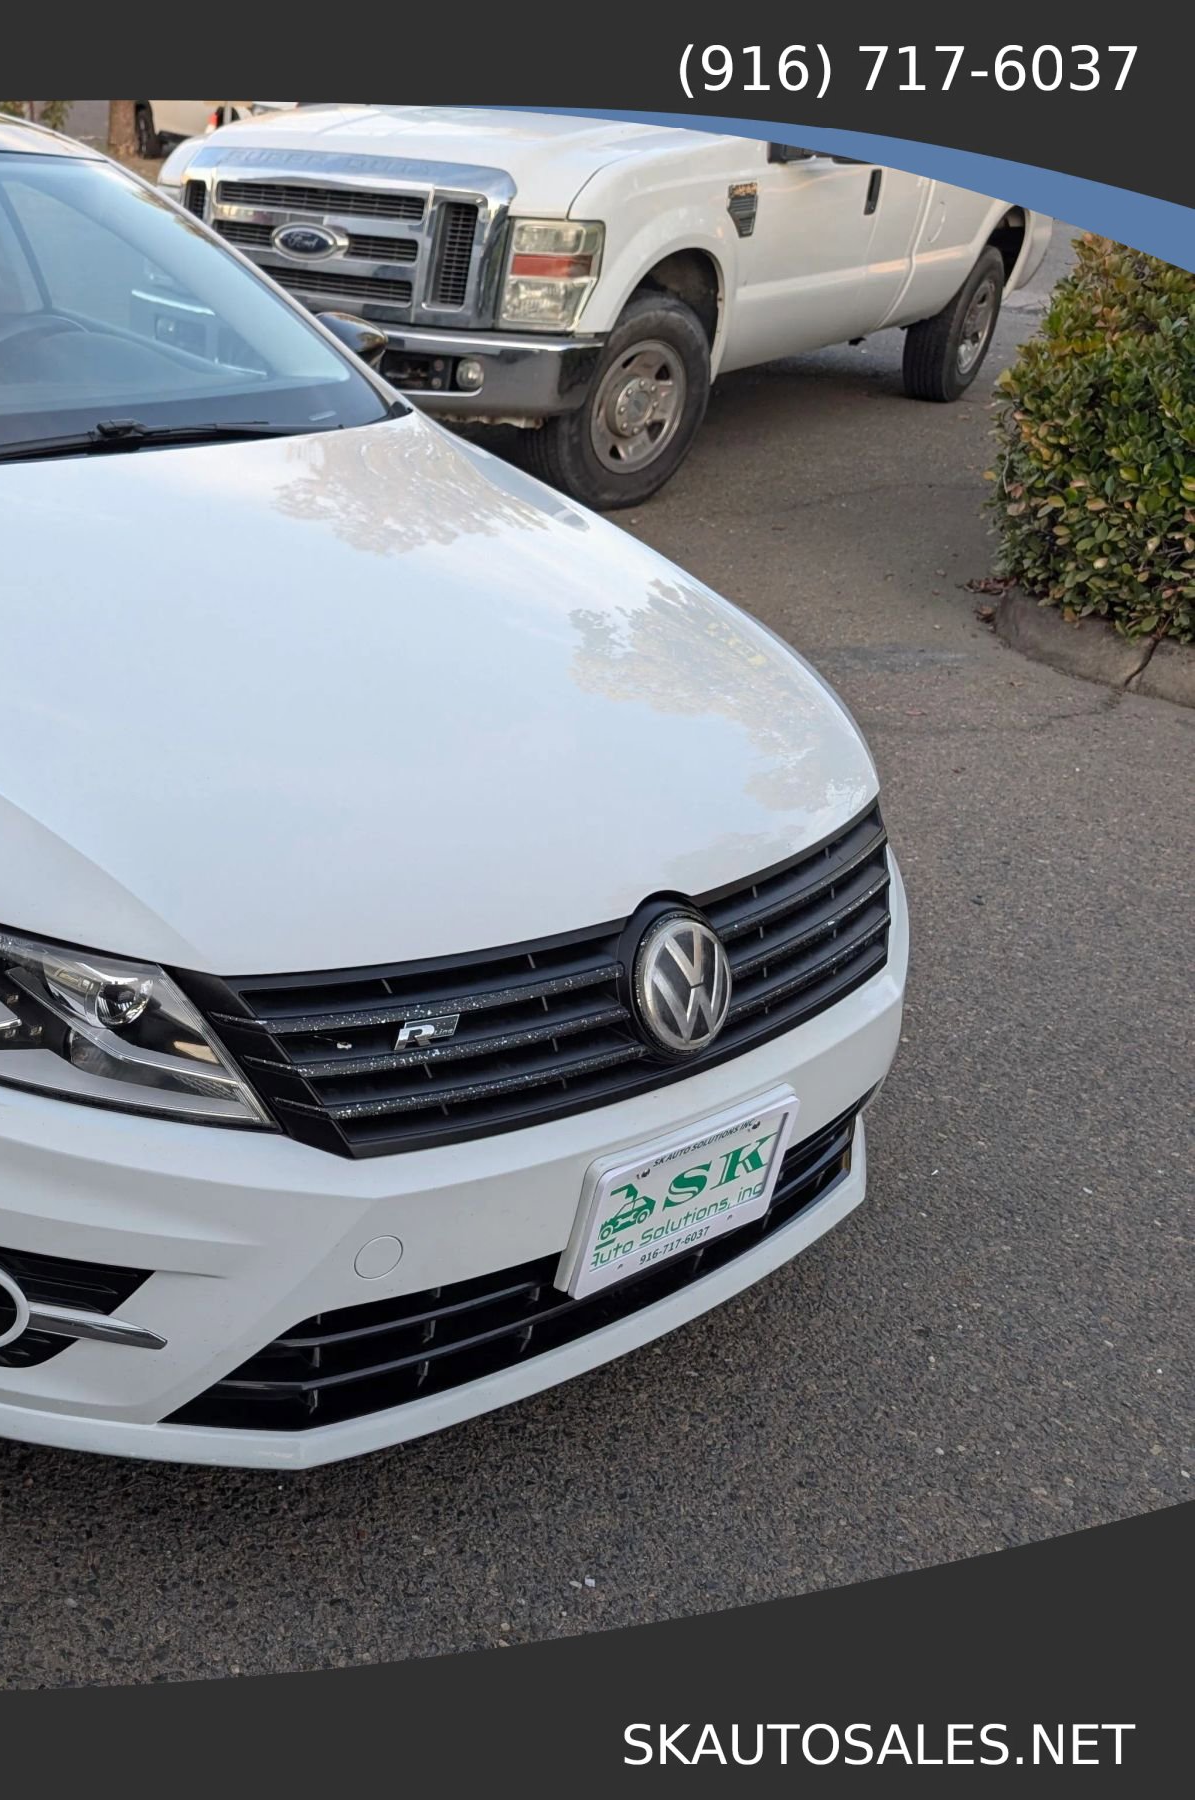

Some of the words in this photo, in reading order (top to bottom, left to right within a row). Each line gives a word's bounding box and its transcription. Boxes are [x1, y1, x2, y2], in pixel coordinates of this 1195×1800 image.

[287, 230, 320, 249] Ford
[652, 1154, 667, 1167] SK
[665, 1146, 690, 1162] AUTO
[691, 1127, 740, 1152] SOLUTIONS
[662, 1131, 778, 1211] SK
[639, 1196, 731, 1247] Solutions,
[639, 1225, 711, 1266] 916-717-6037
